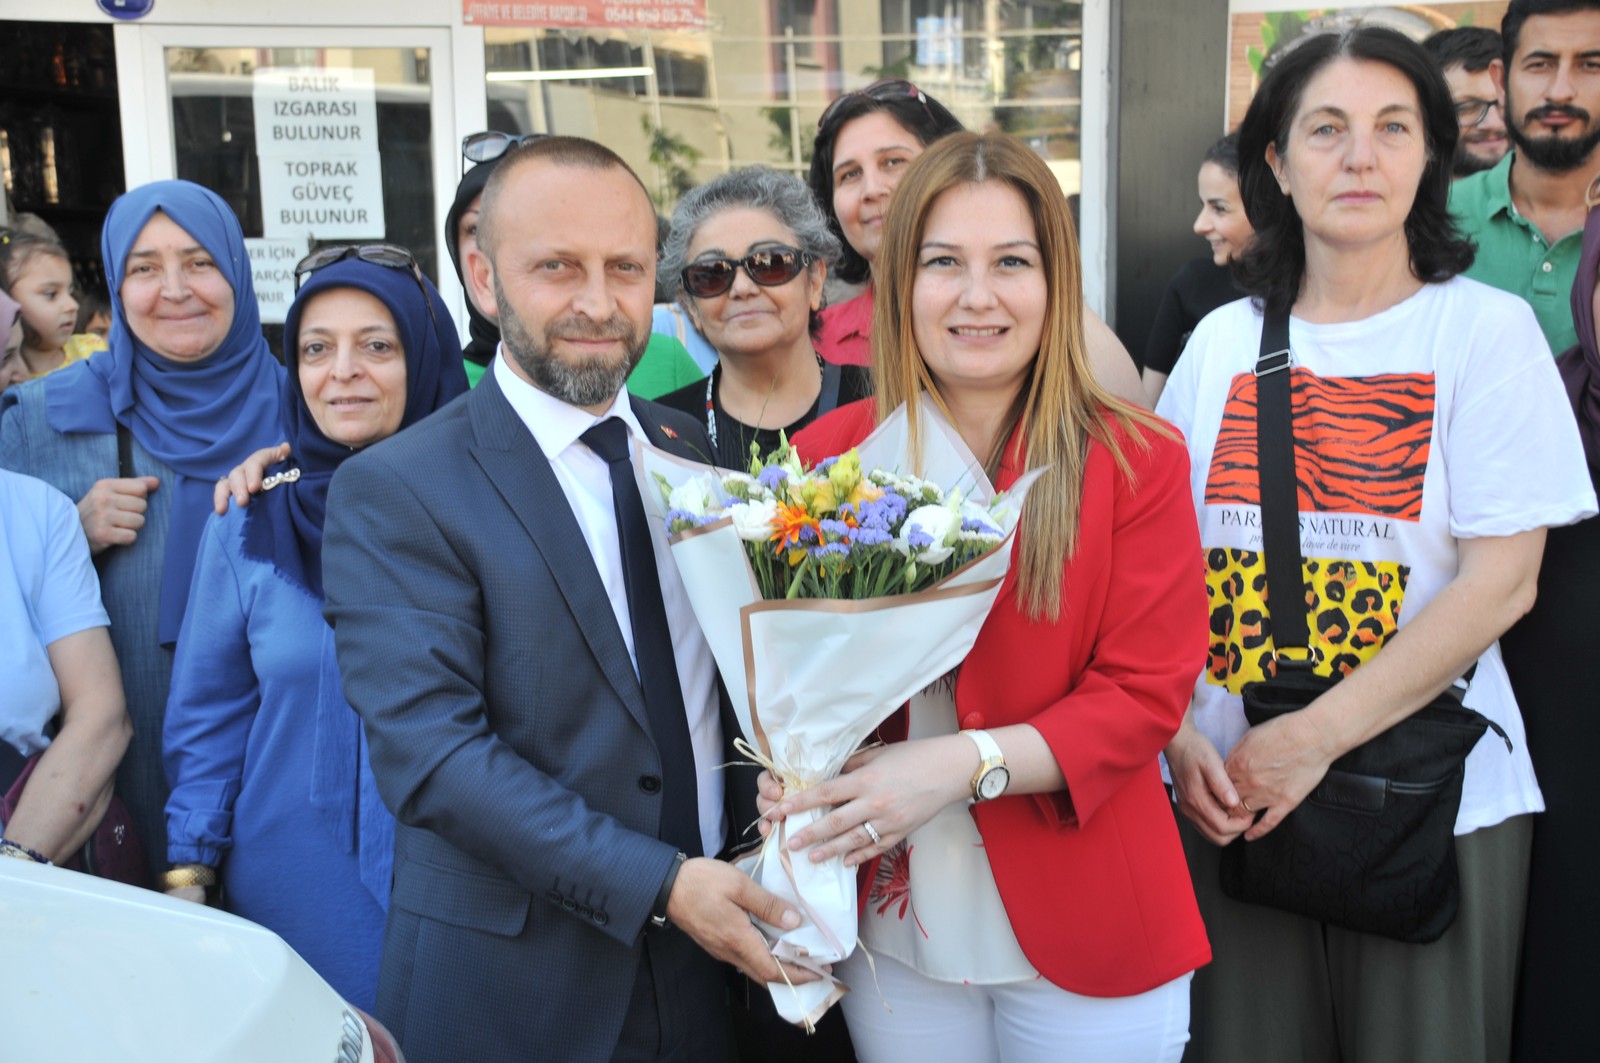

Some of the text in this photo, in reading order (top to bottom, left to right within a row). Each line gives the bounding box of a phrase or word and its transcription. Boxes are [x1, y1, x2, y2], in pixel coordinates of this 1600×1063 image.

[605, 7, 634, 22] 0544
[288, 77, 340, 92] BALIK
[274, 101, 357, 116] IZGARASI
[273, 125, 361, 140] BULUNUR
[285, 162, 357, 177] TOPRAK
[292, 181, 354, 204] GÜVEÇ
[280, 209, 368, 224] BULUNUR
[249, 245, 296, 261] ER İÇİN
[257, 291, 285, 303] NUR
[1310, 516, 1395, 540] NATURAL
